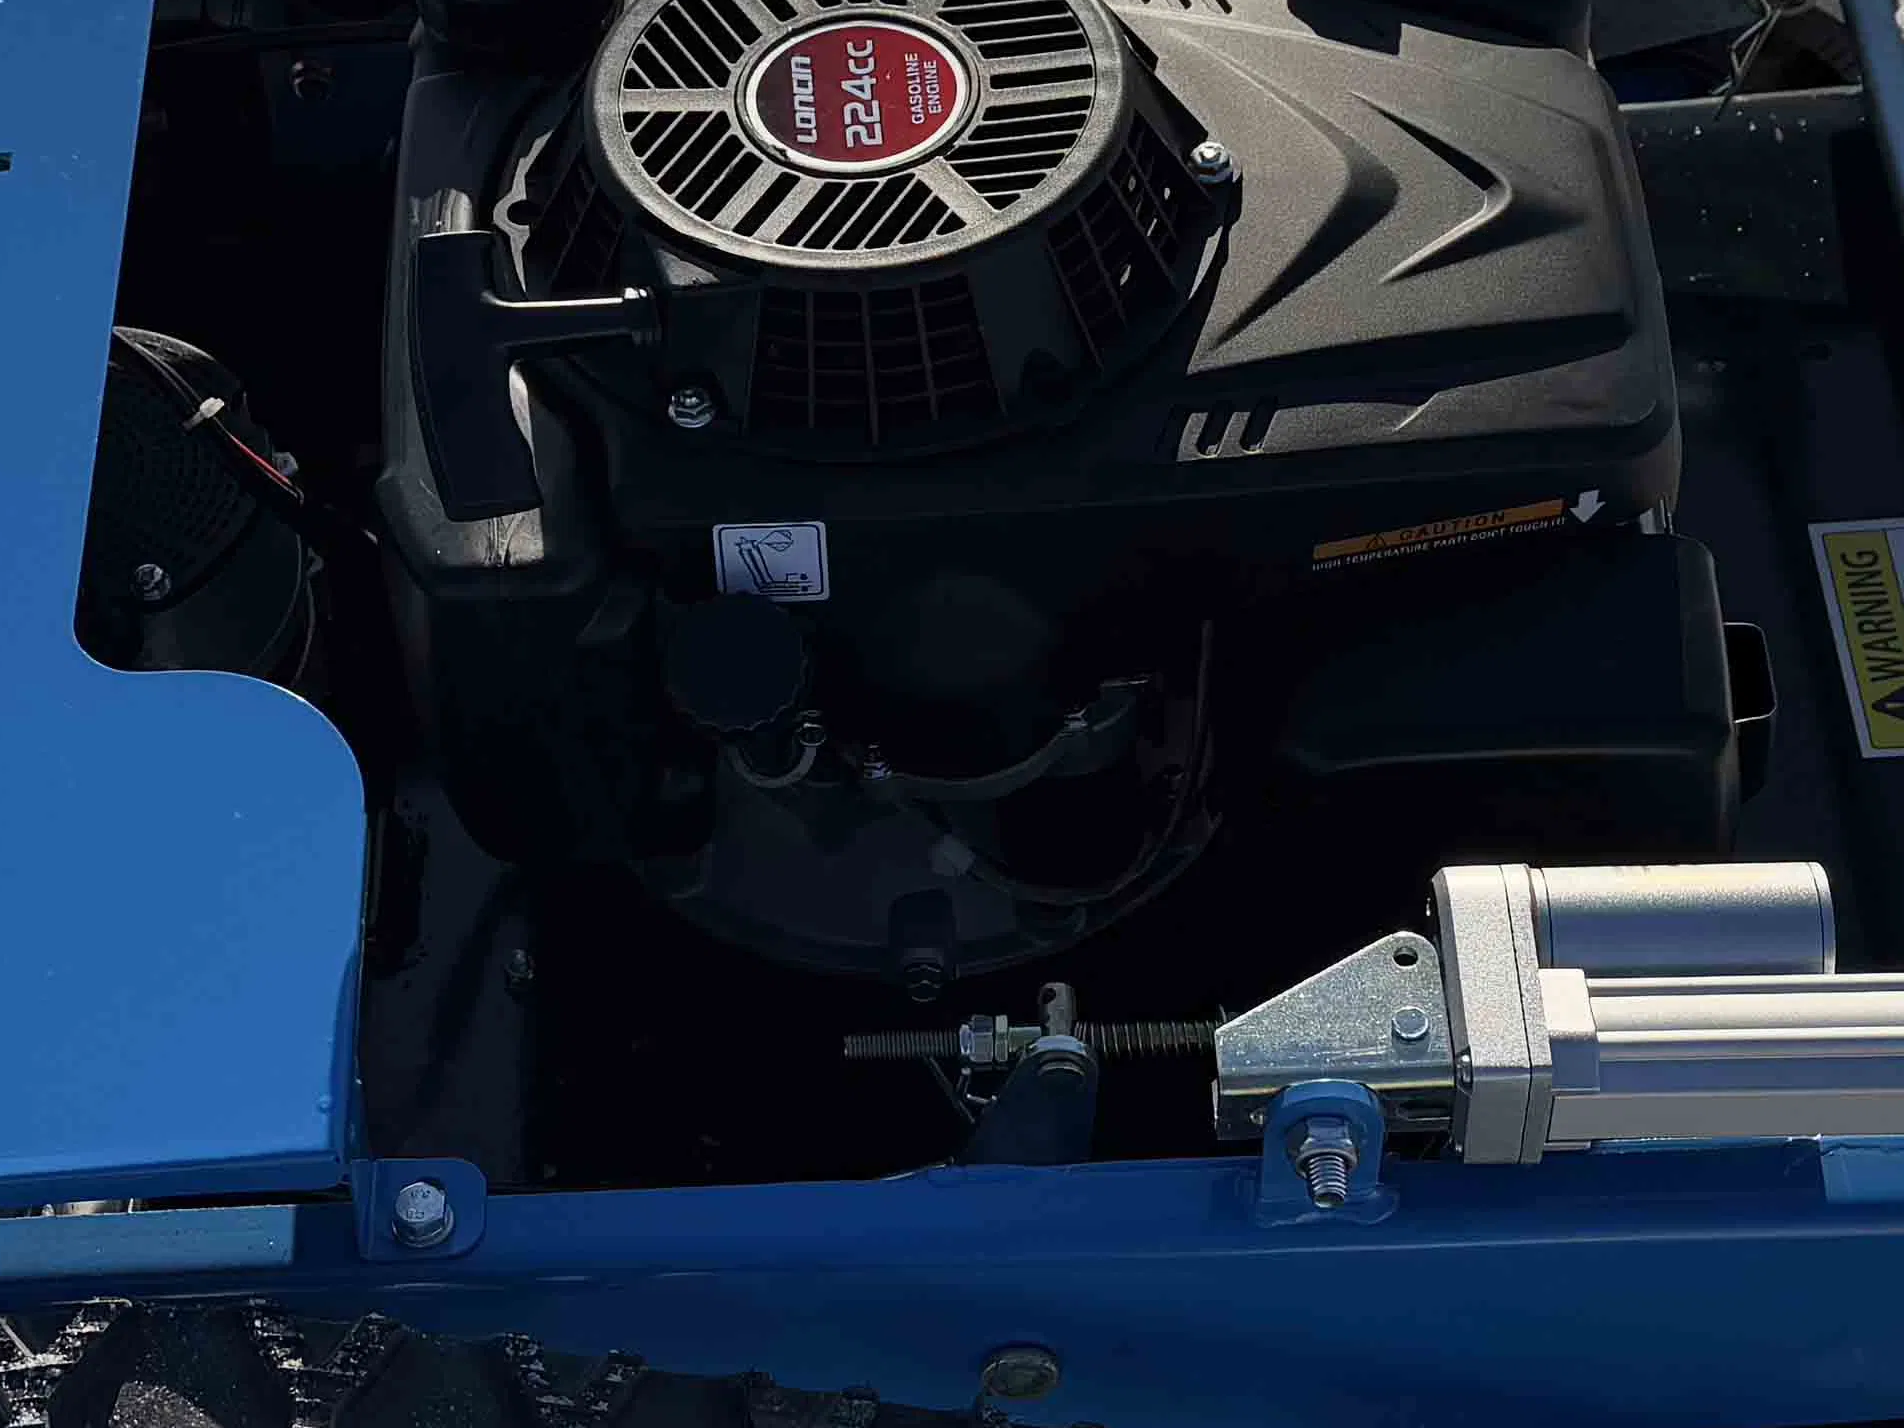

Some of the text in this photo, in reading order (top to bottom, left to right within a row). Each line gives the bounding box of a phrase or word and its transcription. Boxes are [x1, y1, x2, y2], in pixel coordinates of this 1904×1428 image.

[904, 51, 924, 125] GASOLINE
[924, 59, 943, 115] ENGINE
[1399, 512, 1505, 542] CAUTION
